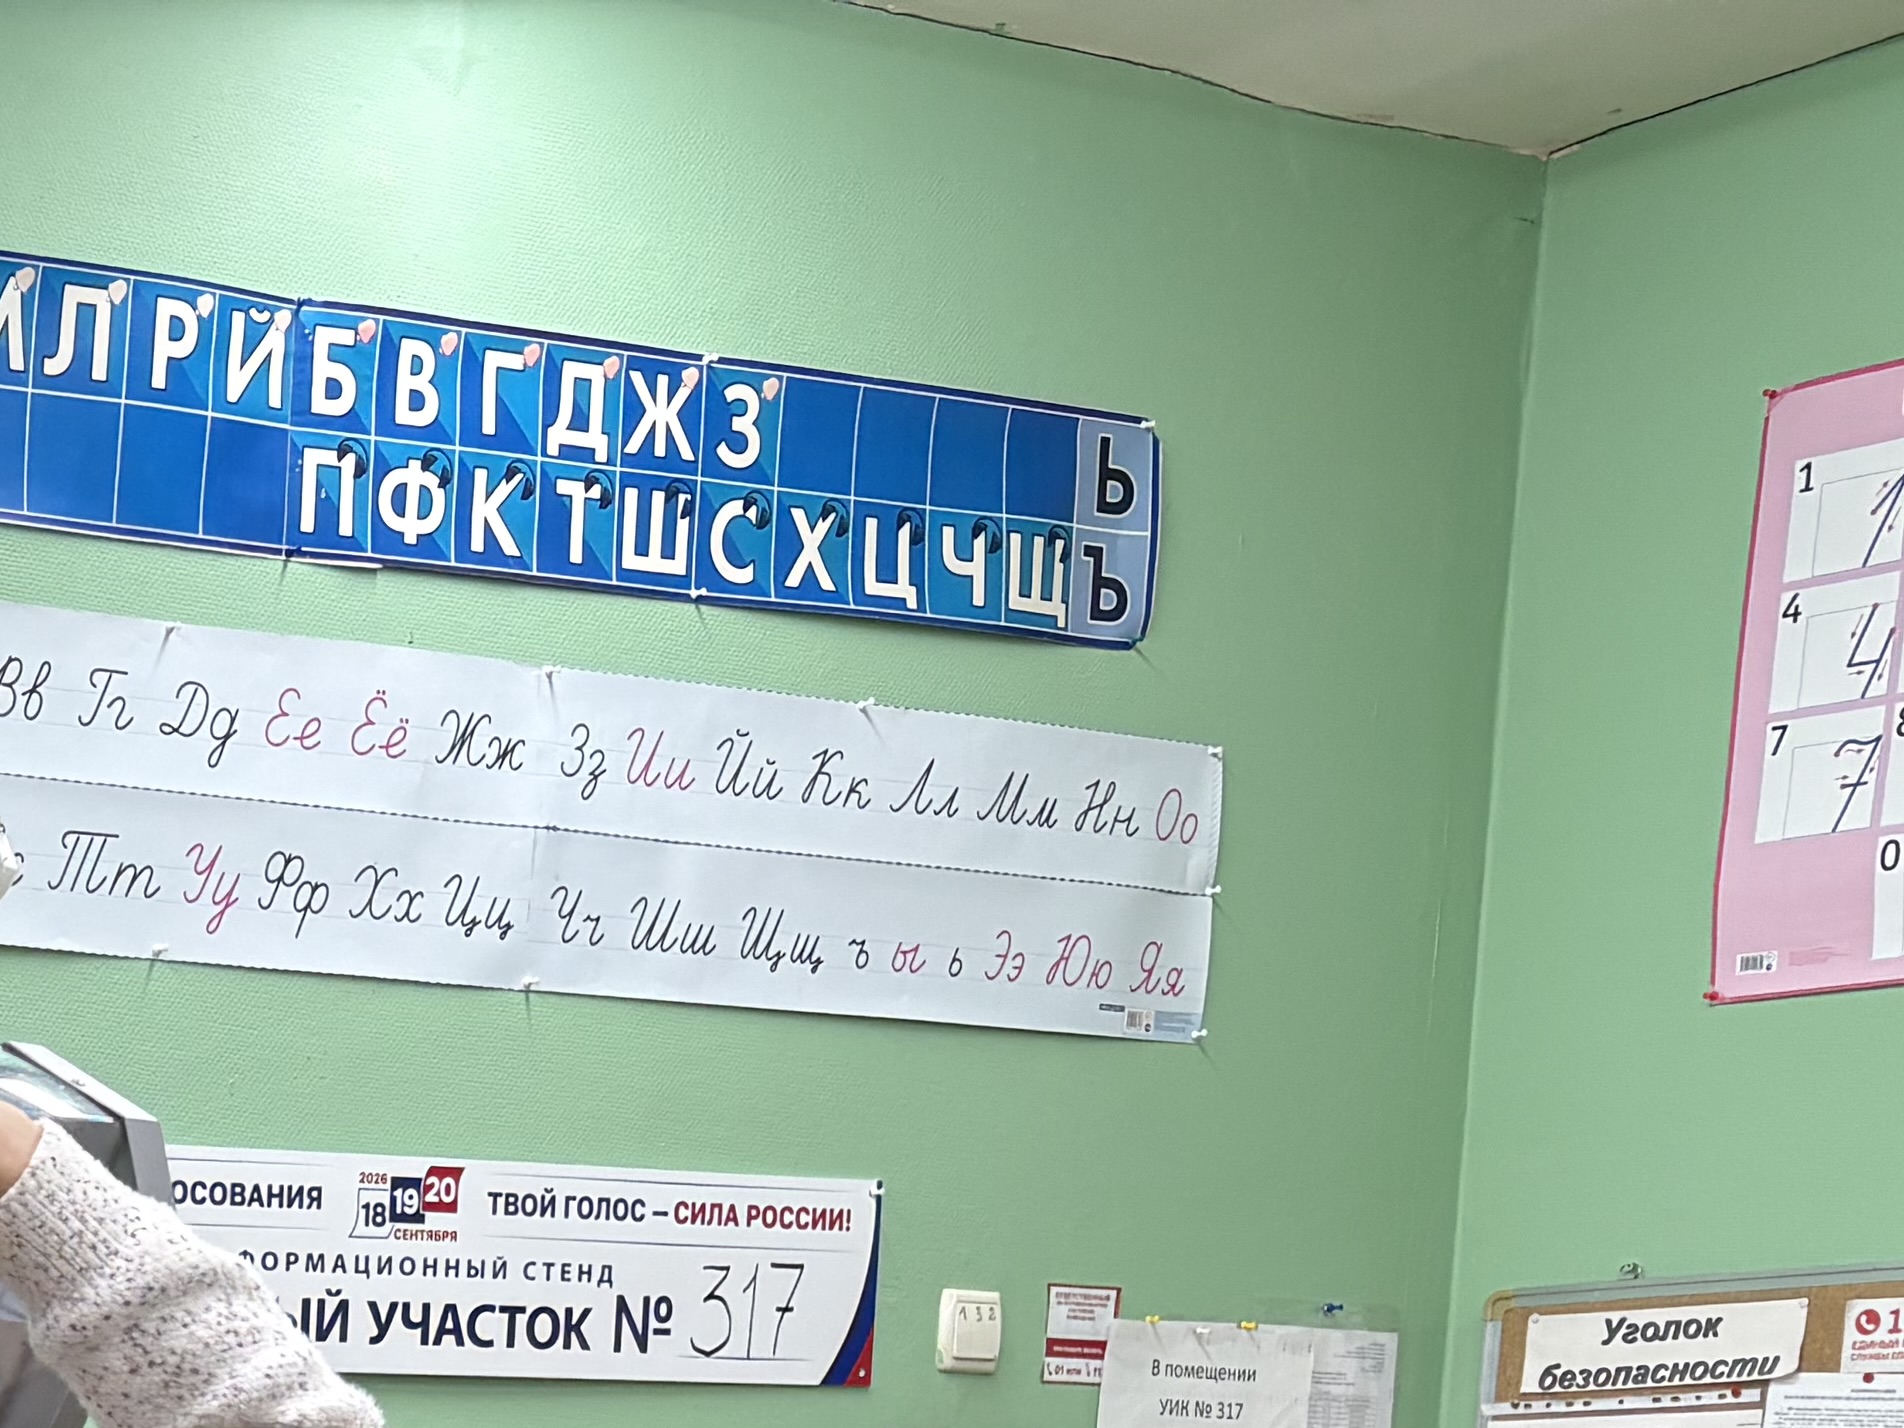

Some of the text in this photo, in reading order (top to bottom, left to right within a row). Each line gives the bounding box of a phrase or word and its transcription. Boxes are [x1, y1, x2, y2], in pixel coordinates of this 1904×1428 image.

[1798, 462, 1815, 493] 1
[1781, 593, 1802, 624] 4
[79, 667, 133, 727] Гг
[160, 681, 238, 769] Дд
[265, 687, 321, 751] Ее
[351, 690, 406, 759] Ёё
[434, 709, 526, 772] Жж
[561, 723, 607, 800] Зз
[626, 727, 696, 791] Ии
[714, 729, 783, 801] Йй
[801, 749, 872, 810] Кк
[889, 759, 959, 817] Лл
[976, 771, 1058, 830] Мм
[1074, 779, 1141, 839] Нн
[1155, 789, 1199, 845] Оо
[1769, 726, 1788, 757] 7
[48, 831, 161, 901] Тт
[183, 842, 241, 933] Уу
[257, 851, 331, 939] Фф
[349, 865, 423, 925] Хх
[444, 875, 514, 936] Цц
[551, 886, 605, 947] Чч
[631, 896, 718, 956] Шш
[741, 906, 825, 976] Щщ
[984, 931, 1025, 983] Ээ
[1046, 935, 1112, 990] Юю
[1130, 941, 1186, 998] Яя
[358, 1171, 387, 1185] 2026
[424, 1176, 457, 1204] 20
[172, 1180, 323, 1209] ОСОВАНИЯ
[392, 1187, 420, 1215] 19
[487, 1188, 852, 1232] ТВОЙ ГОЛОС СИЛА РОССИИ!
[361, 1200, 386, 1228] 18
[393, 1227, 458, 1243] СЕНТЯБРЯ
[239, 1249, 614, 1288] ОРМАЦИОННЫЙ СТЕНД
[367, 1300, 592, 1351] УЧАСТОК
[613, 1294, 673, 1354] №
[690, 1262, 804, 1360] 317
[1601, 1316, 1723, 1346] Уголок
[1151, 1359, 1258, 1387] В помещении
[1538, 1354, 1781, 1390] безопасности
[1159, 1398, 1244, 1420] УИК № 317
